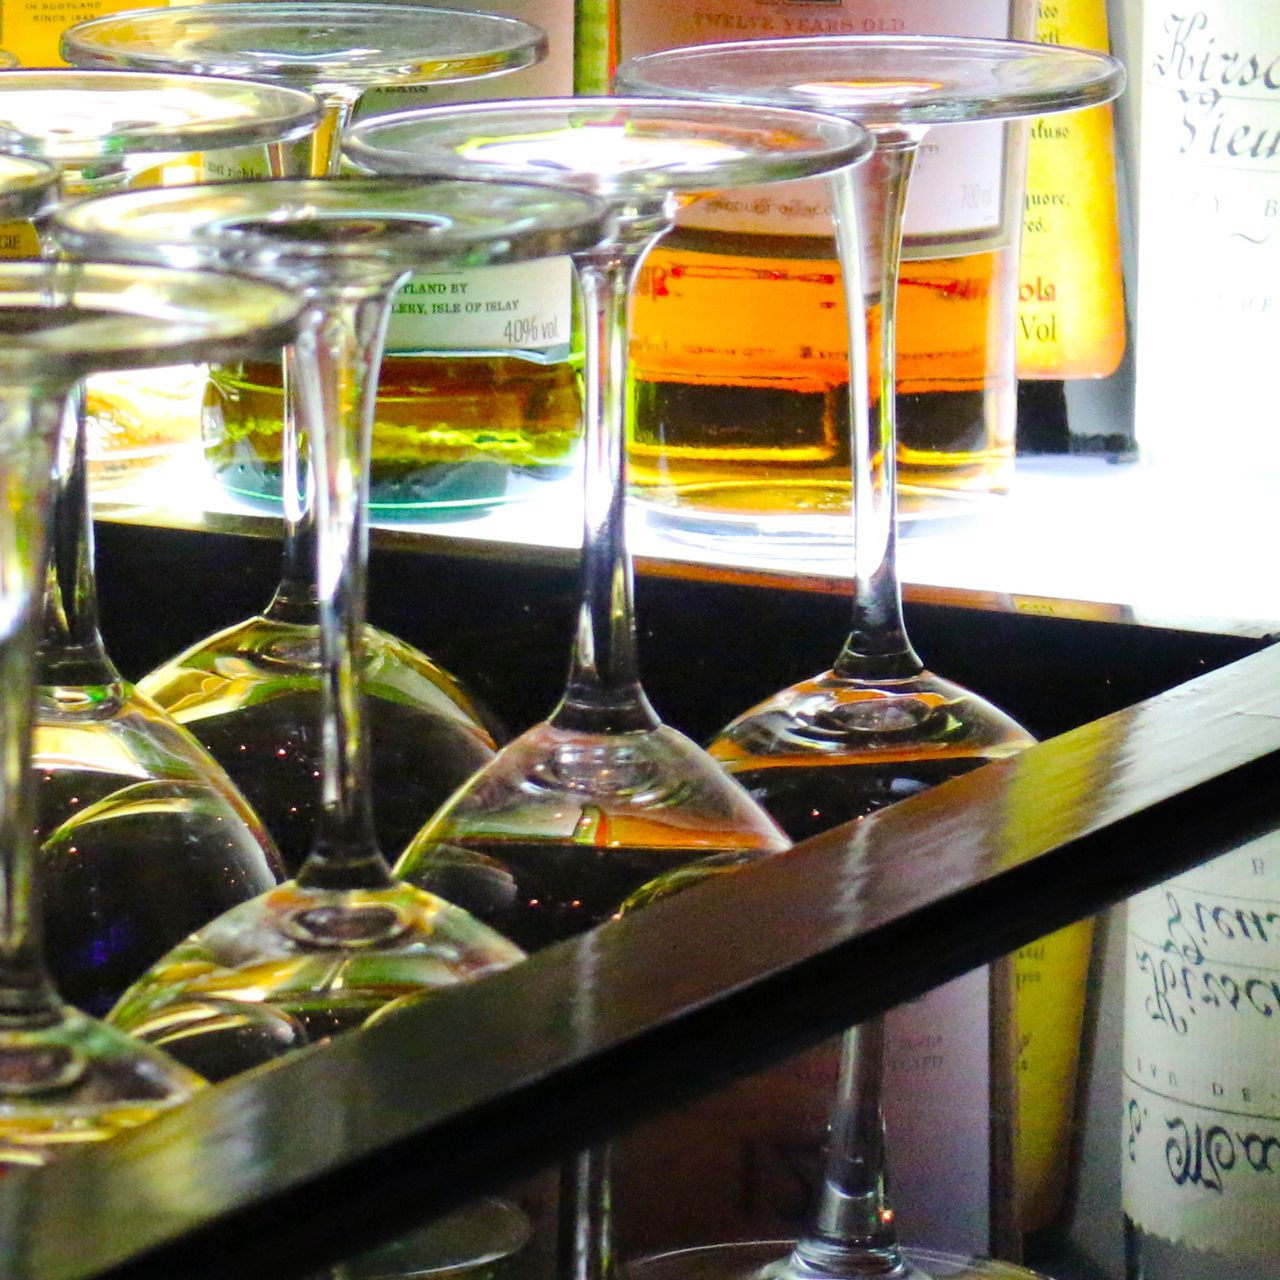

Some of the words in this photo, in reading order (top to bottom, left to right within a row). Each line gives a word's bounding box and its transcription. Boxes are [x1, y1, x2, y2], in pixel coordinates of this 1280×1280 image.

[40, 0, 102, 10] SCOTLAND
[397, 282, 446, 295] TLAND
[450, 283, 469, 295] BY
[432, 302, 462, 315] ISLE
[465, 302, 482, 314] OF
[485, 299, 520, 313] ISLAY
[503, 315, 539, 344] 40%
[1019, 314, 1057, 343] Vol
